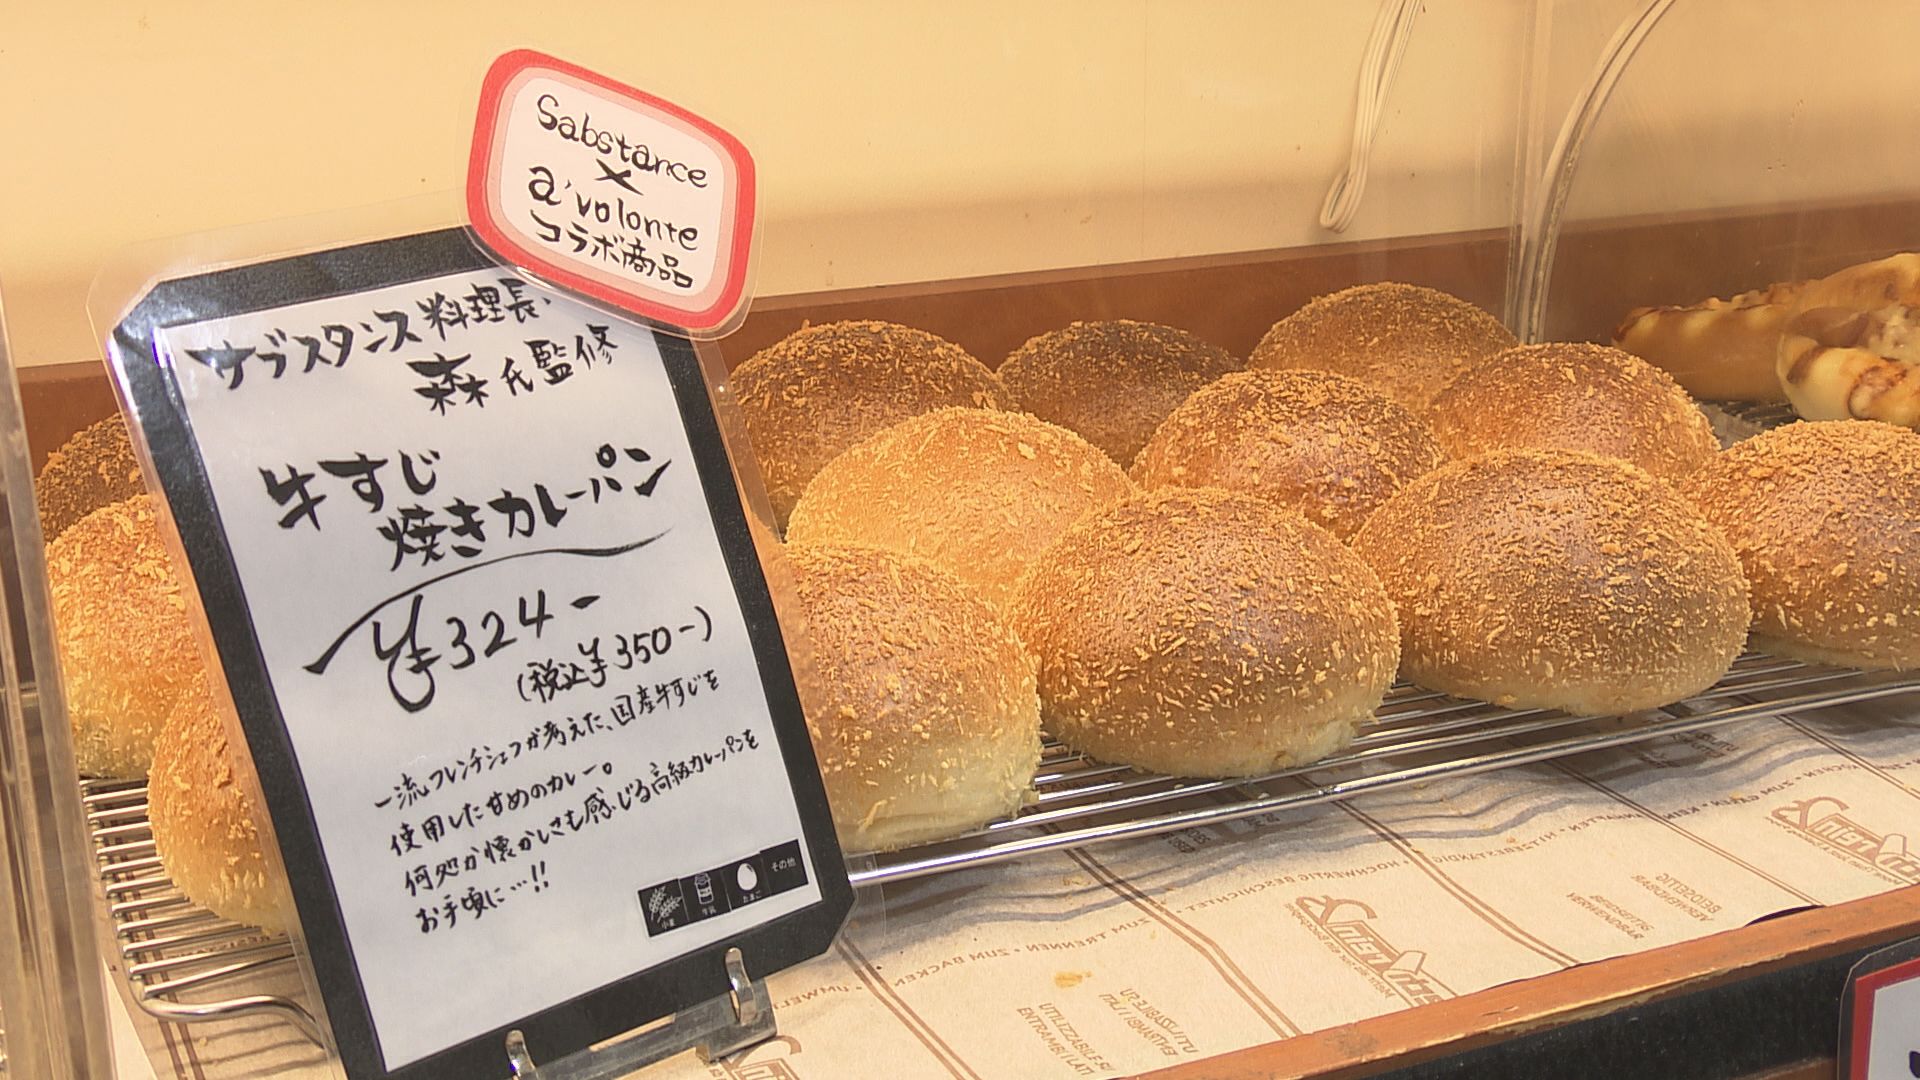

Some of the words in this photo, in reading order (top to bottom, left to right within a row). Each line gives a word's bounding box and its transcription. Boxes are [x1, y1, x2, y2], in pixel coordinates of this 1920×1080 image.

[537, 94, 707, 188] Sabstance
[530, 209, 693, 289] コラボ商品
[258, 449, 440, 531] 牛すじ
[377, 443, 672, 572] 焼きカレーパン
[390, 762, 613, 856] 使用した甘めのカレー。
[772, 857, 797, 872] その他
